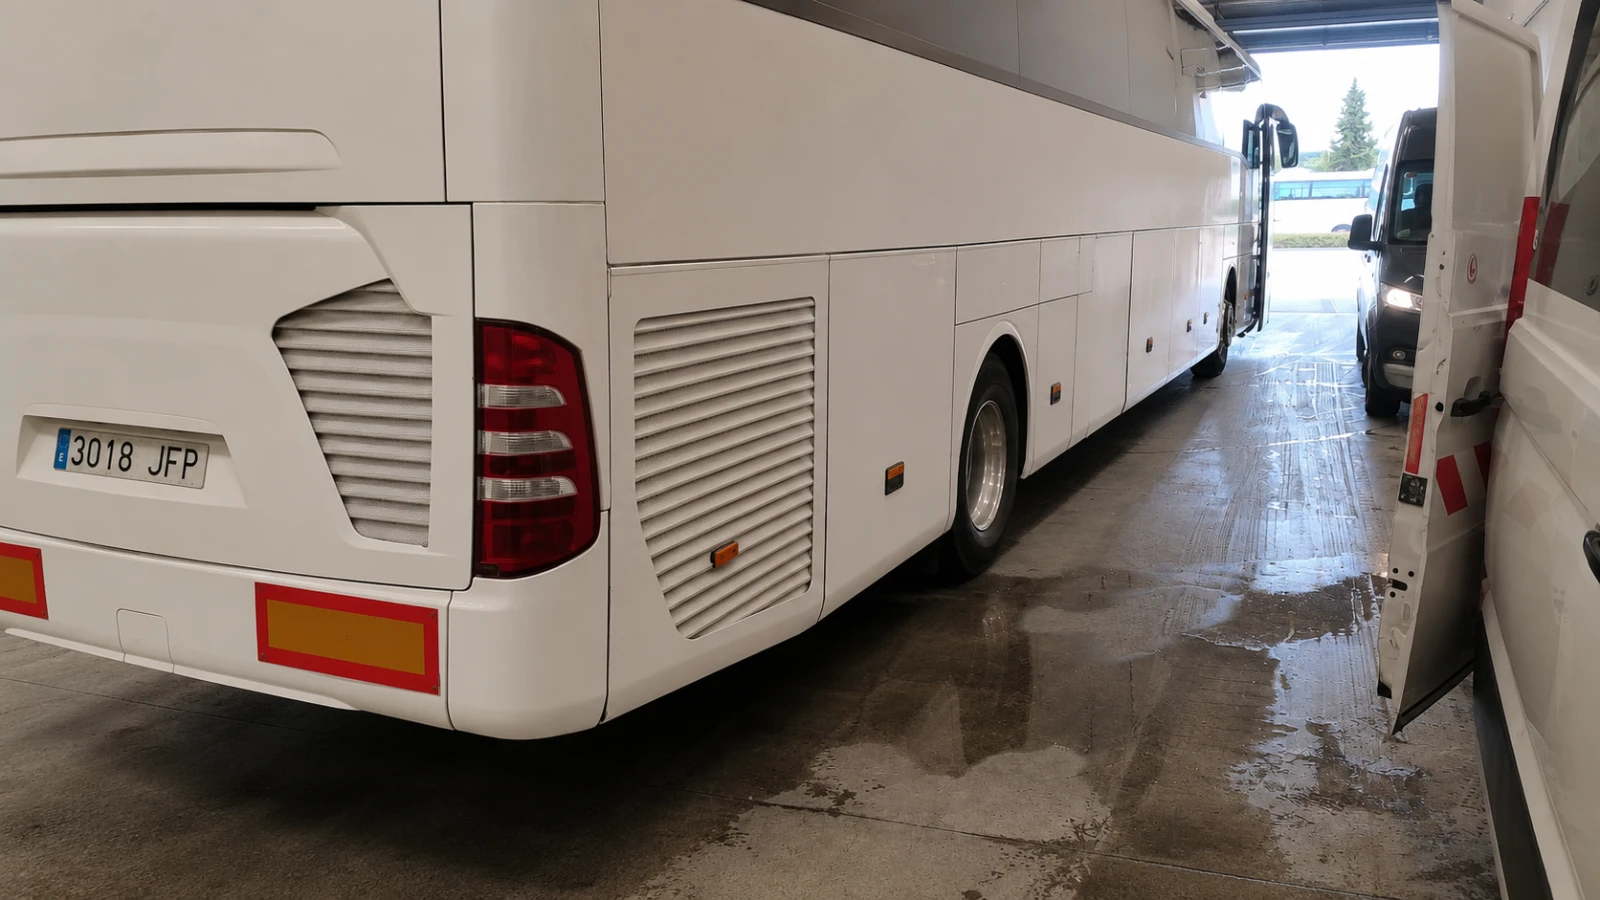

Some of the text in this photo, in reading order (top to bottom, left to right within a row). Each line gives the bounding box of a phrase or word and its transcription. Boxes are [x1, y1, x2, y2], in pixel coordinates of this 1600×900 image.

[58, 453, 64, 462] E
[71, 435, 199, 480] 3018 JFP
